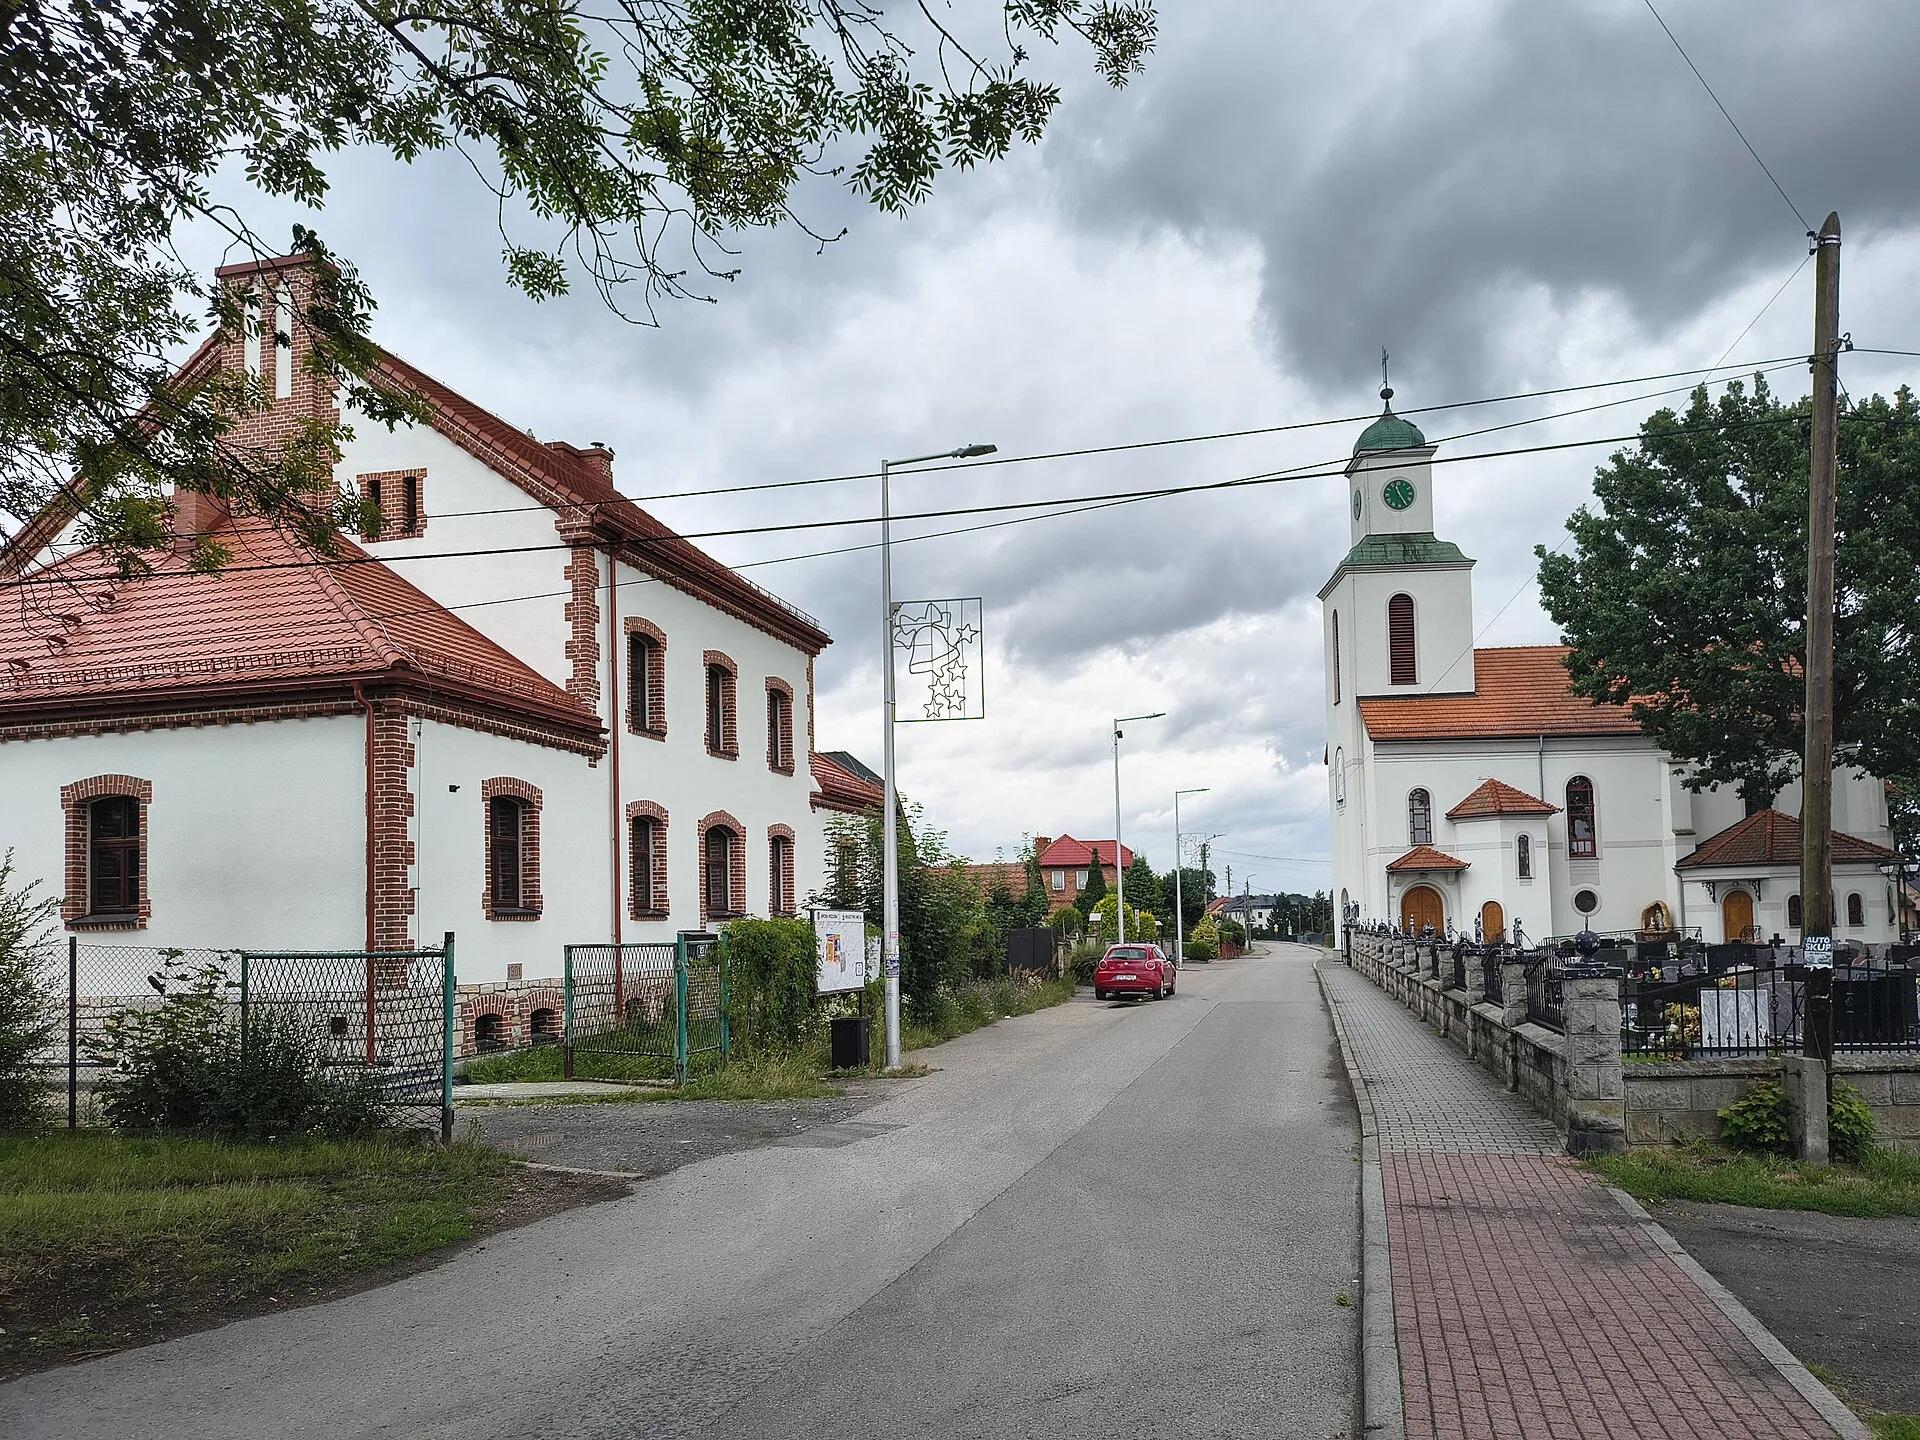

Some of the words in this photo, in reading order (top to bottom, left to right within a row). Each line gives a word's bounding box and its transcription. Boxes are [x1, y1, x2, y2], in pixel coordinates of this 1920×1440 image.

[1806, 936, 1830, 944] AUTO
[1805, 943, 1831, 951] SKUP
[508, 965, 520, 977] 1901
